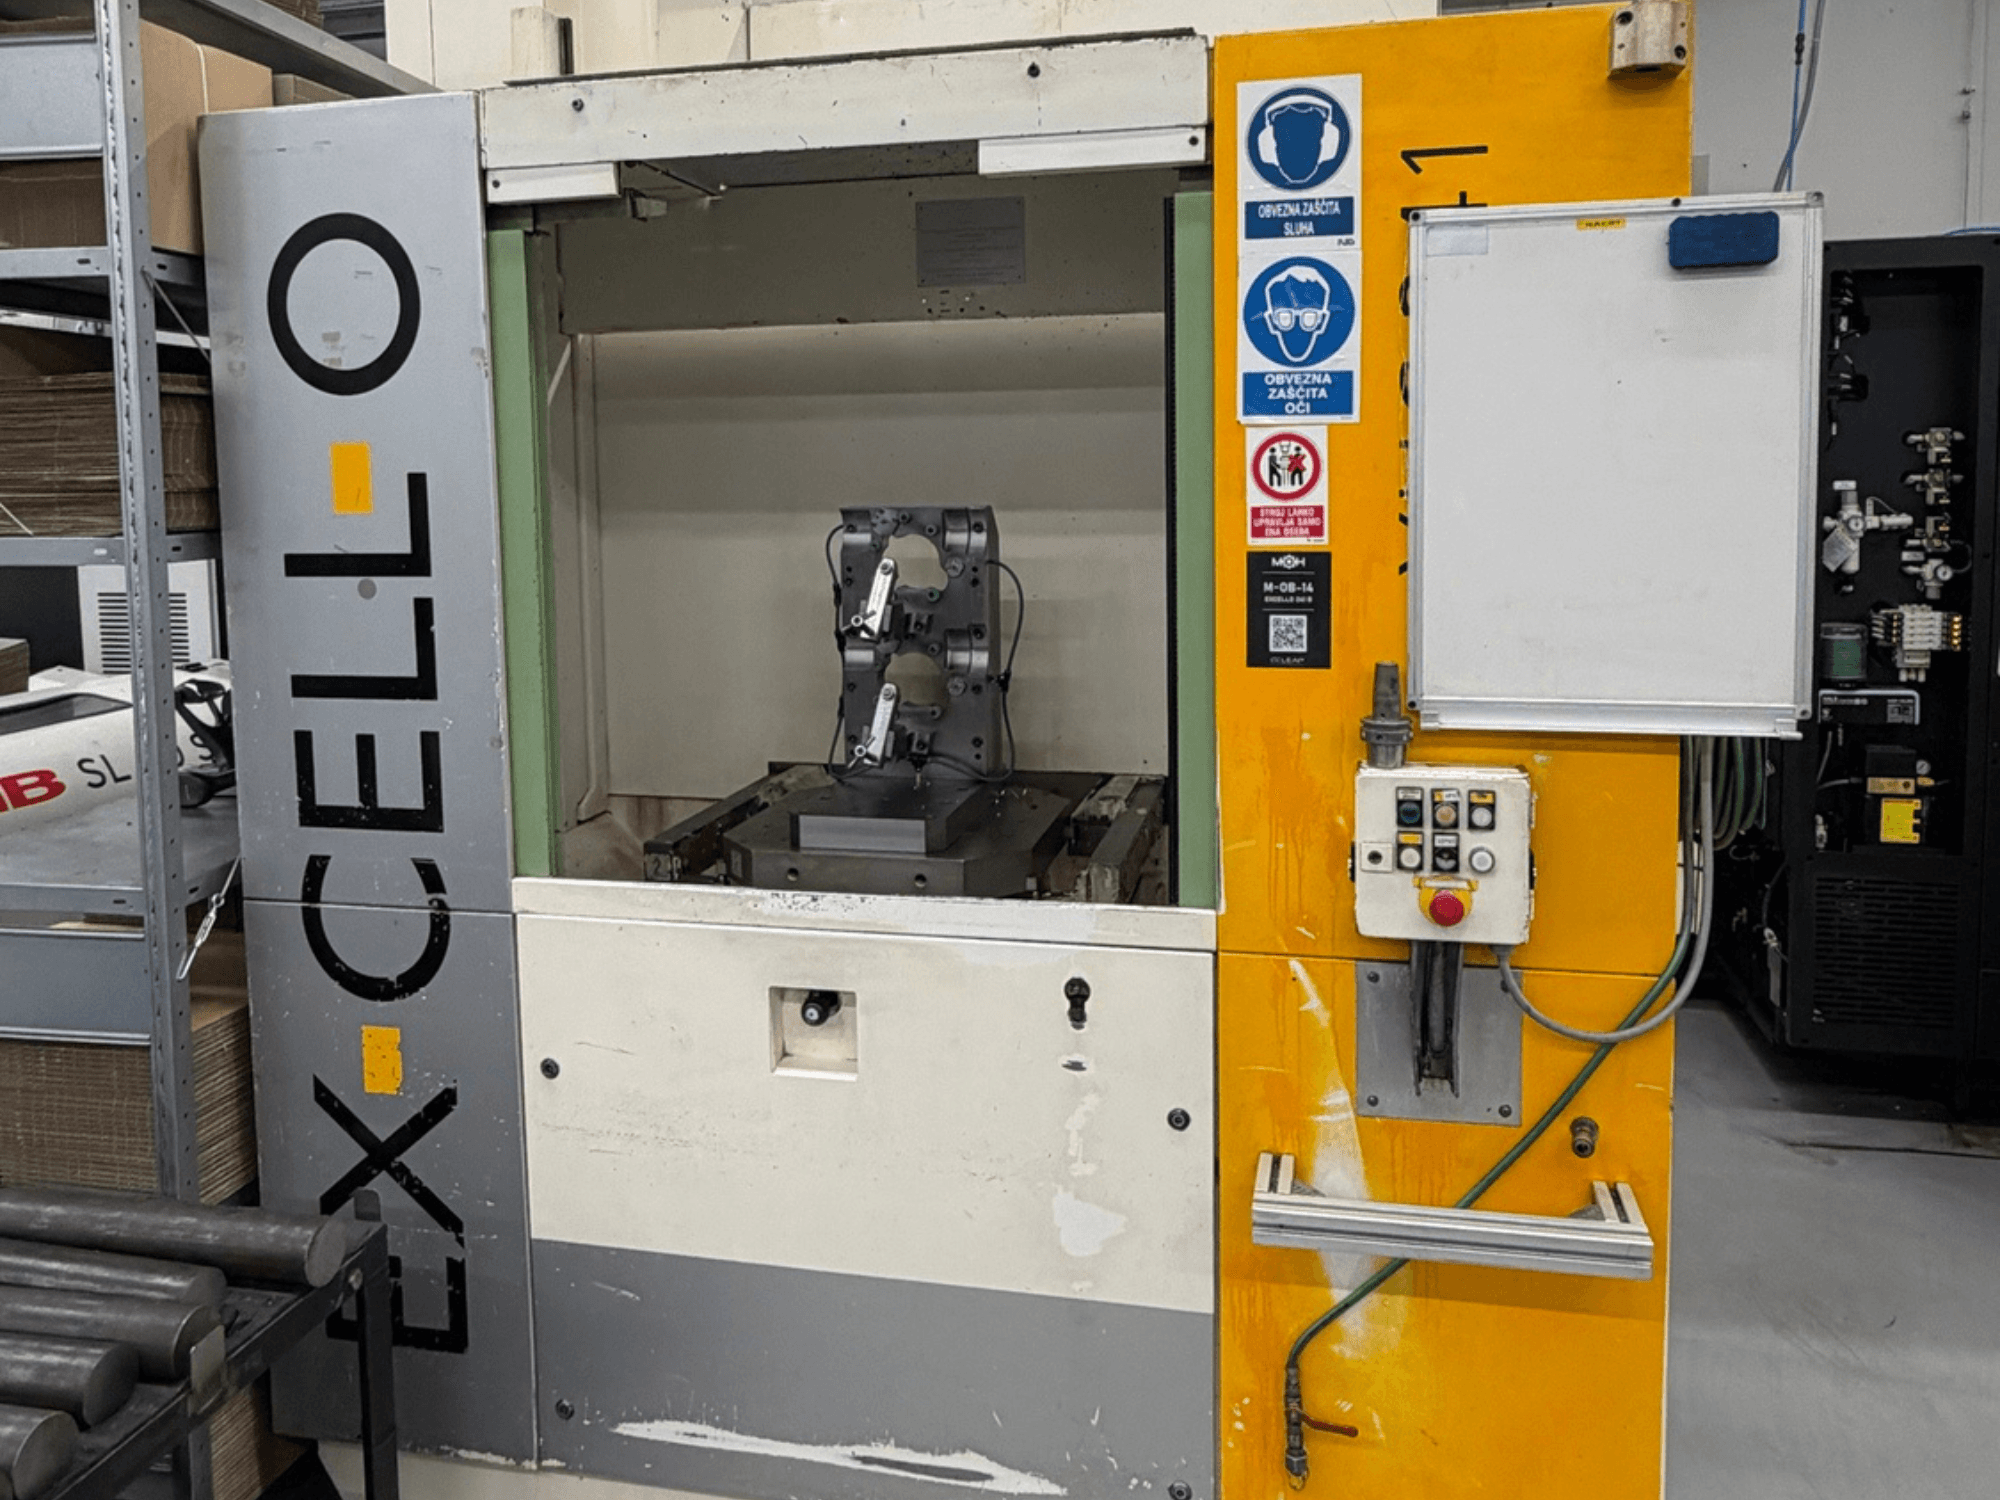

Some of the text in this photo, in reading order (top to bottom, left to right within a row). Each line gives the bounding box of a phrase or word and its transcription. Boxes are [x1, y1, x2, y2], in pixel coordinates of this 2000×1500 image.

[1258, 202, 1301, 218] OBVEZNA
[1283, 221, 1315, 236] SLUHA
[1264, 373, 1332, 385] OBVEZNA
[1267, 385, 1328, 399] ZAŠČITA
[1284, 400, 1311, 414] OČI
[1259, 506, 1315, 517] STROJ LAHKO
[1263, 581, 1314, 593] M-OB-14
